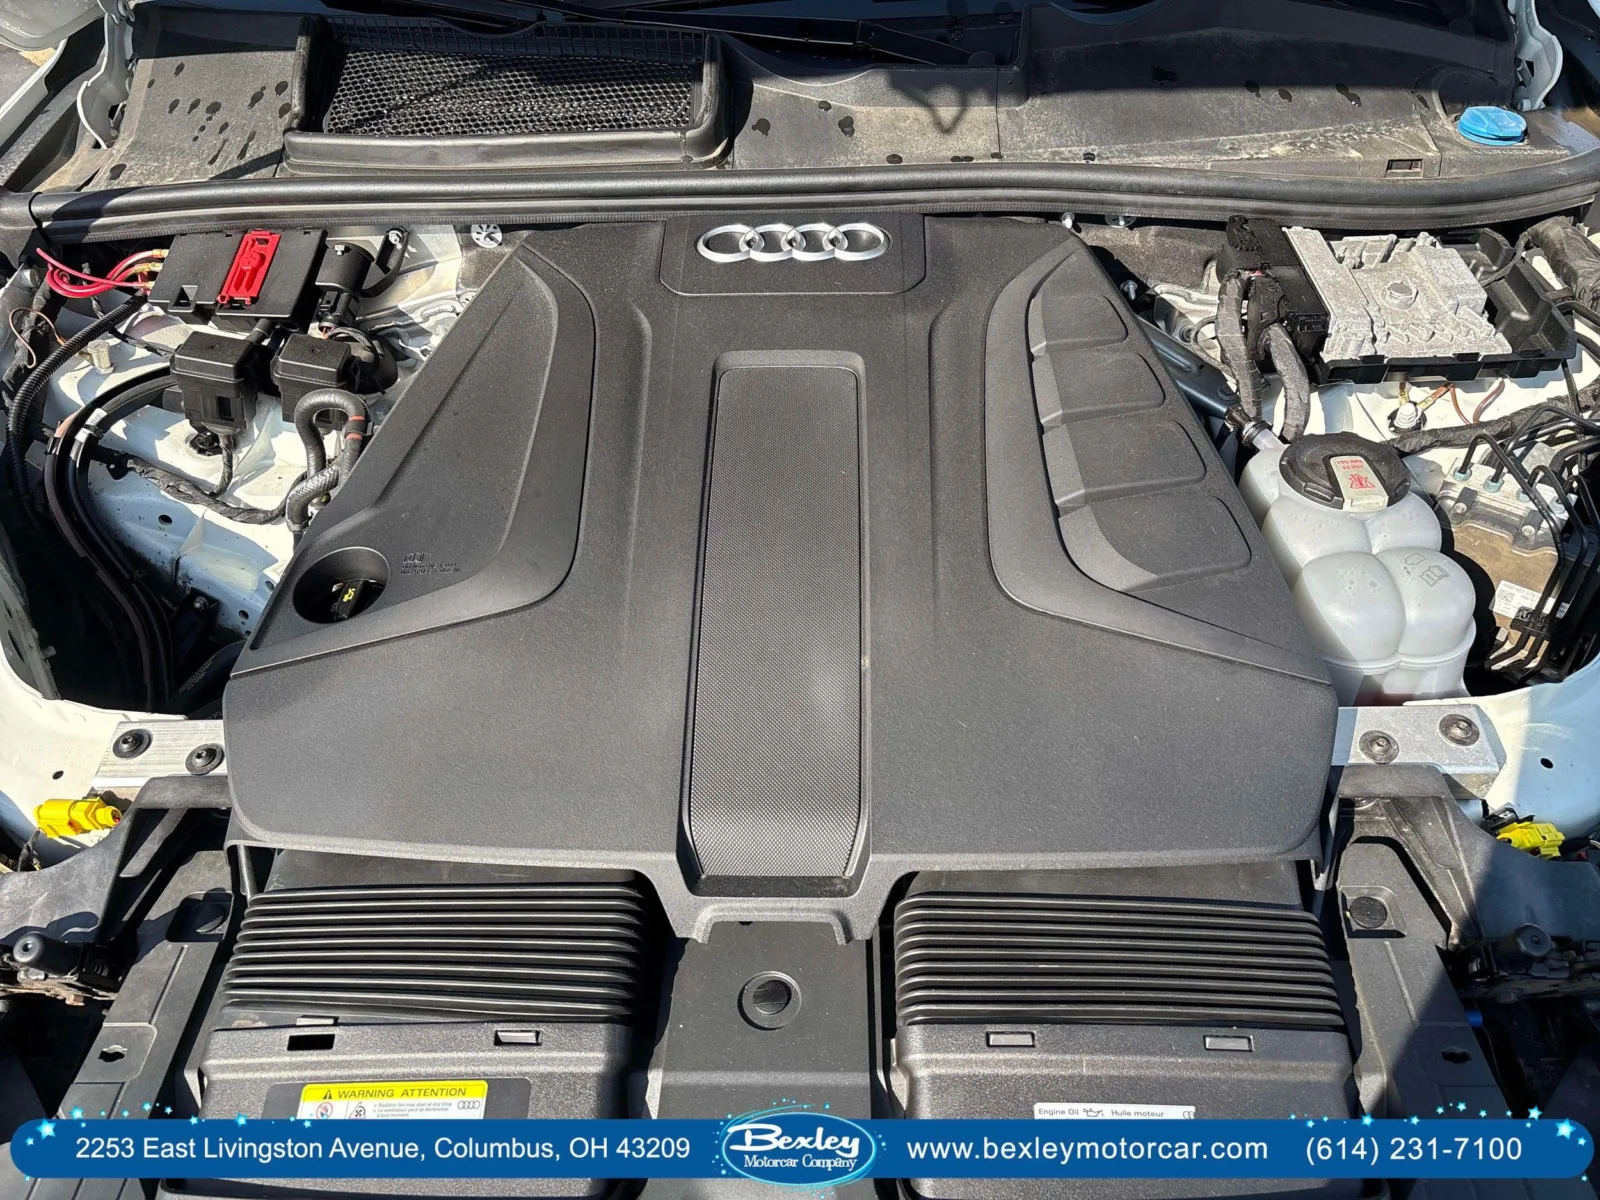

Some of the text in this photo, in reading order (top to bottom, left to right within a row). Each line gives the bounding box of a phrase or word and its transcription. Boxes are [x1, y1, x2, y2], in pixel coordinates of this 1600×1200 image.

[338, 1088, 467, 1099] WARNING ATTENTION
[1038, 1108, 1066, 1116] Engine
[1111, 1109, 1165, 1118] Huile moteur
